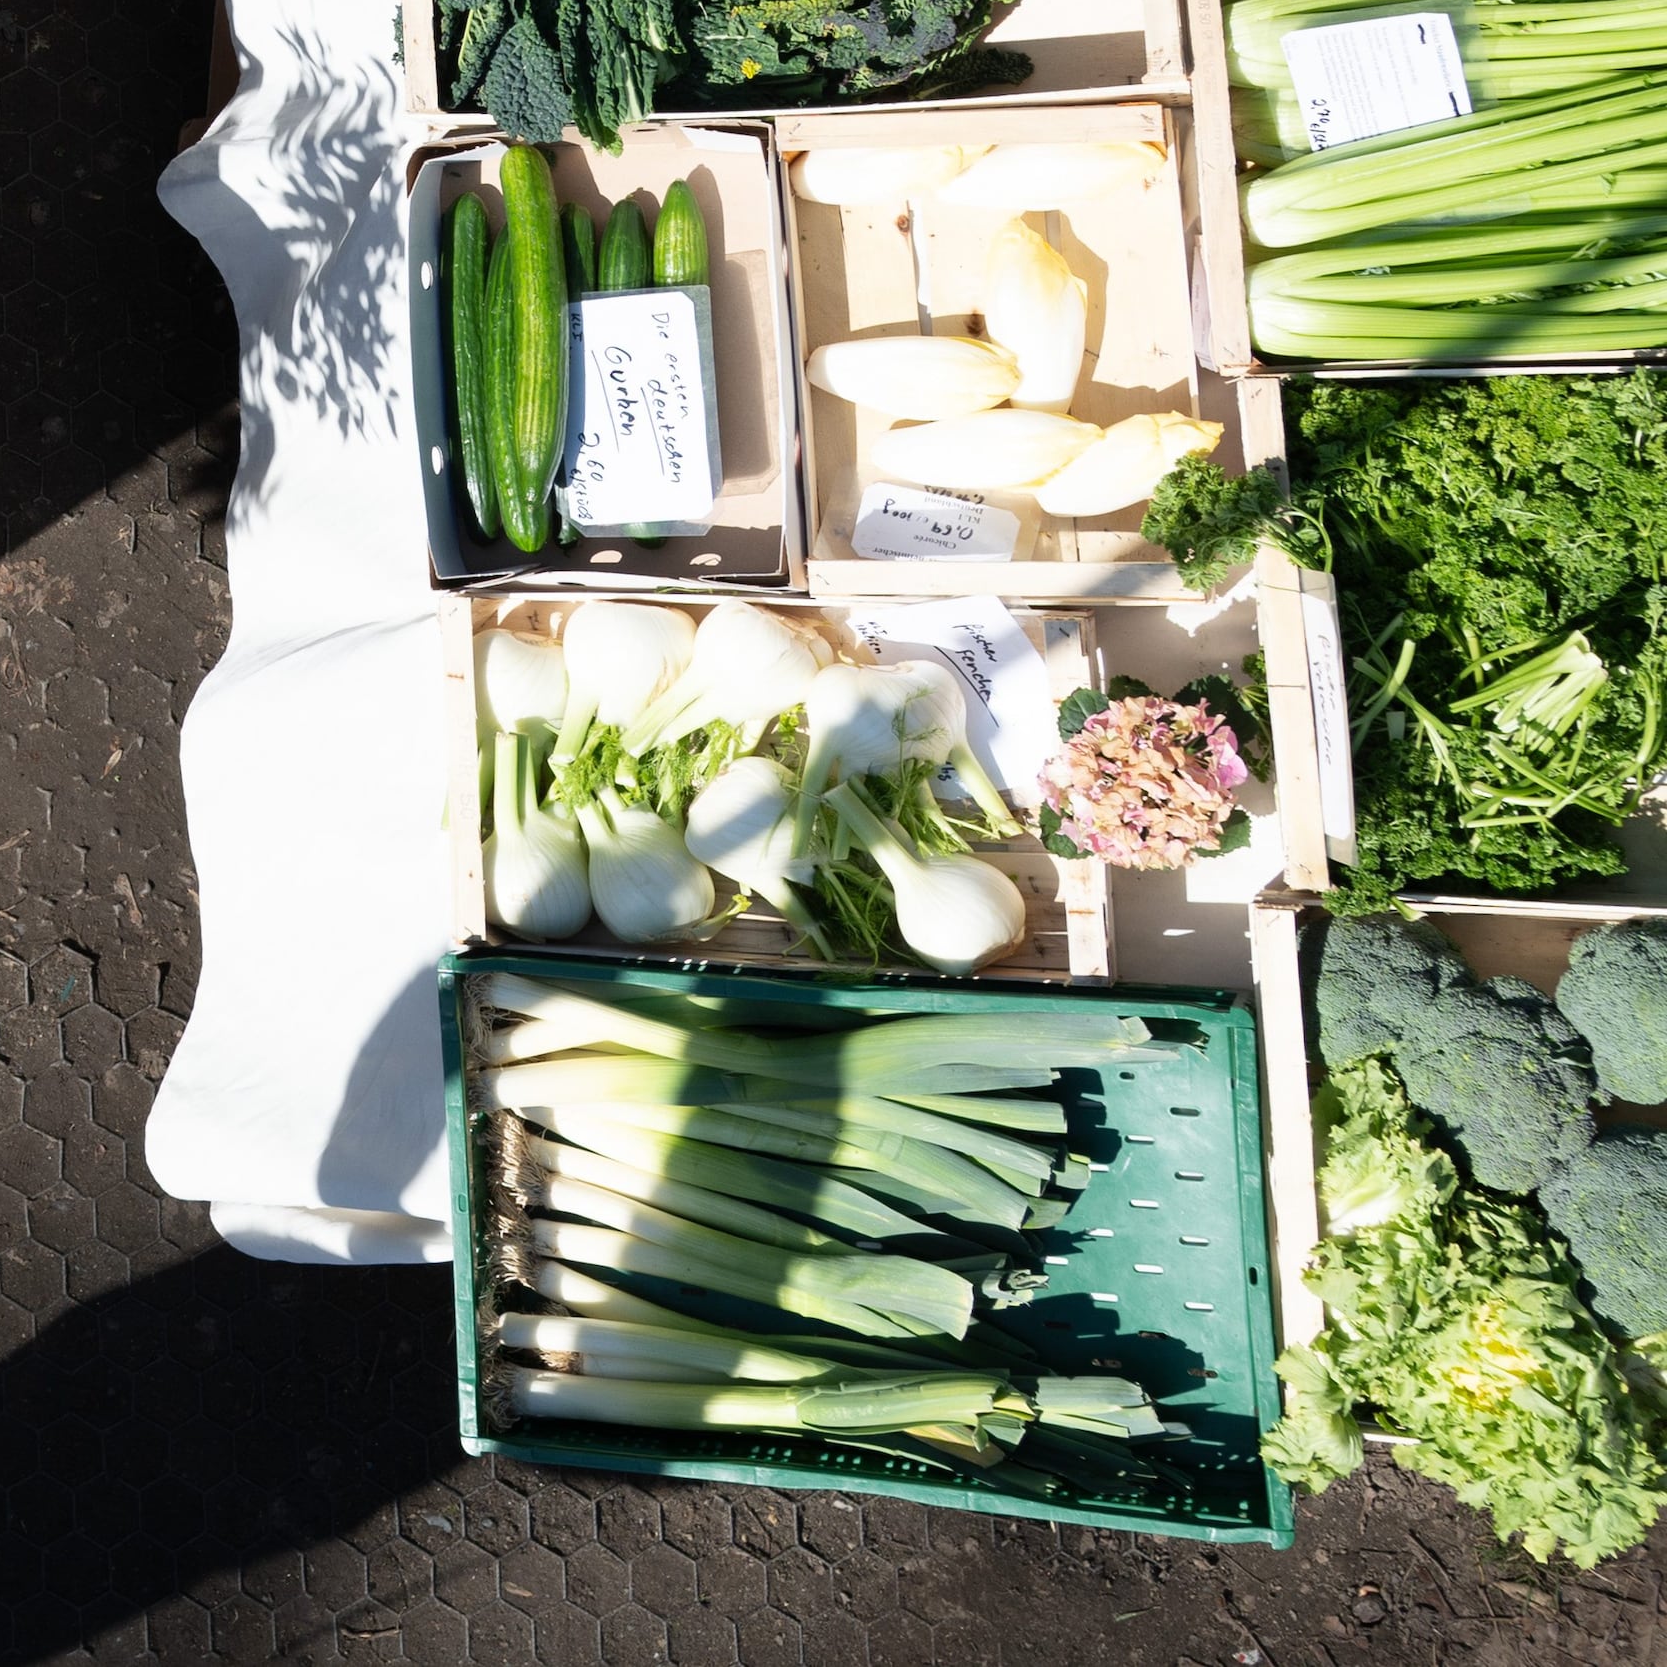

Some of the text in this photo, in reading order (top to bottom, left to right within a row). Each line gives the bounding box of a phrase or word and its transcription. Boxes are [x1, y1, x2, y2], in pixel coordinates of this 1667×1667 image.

[603, 343, 644, 438] Gurken
[650, 311, 691, 419] Die ersten
[574, 429, 606, 484] 2,60
[646, 376, 687, 486] deutschen
[923, 496, 984, 514] Deutschland
[930, 521, 973, 541] 0,69
[911, 534, 956, 549] Chicorée
